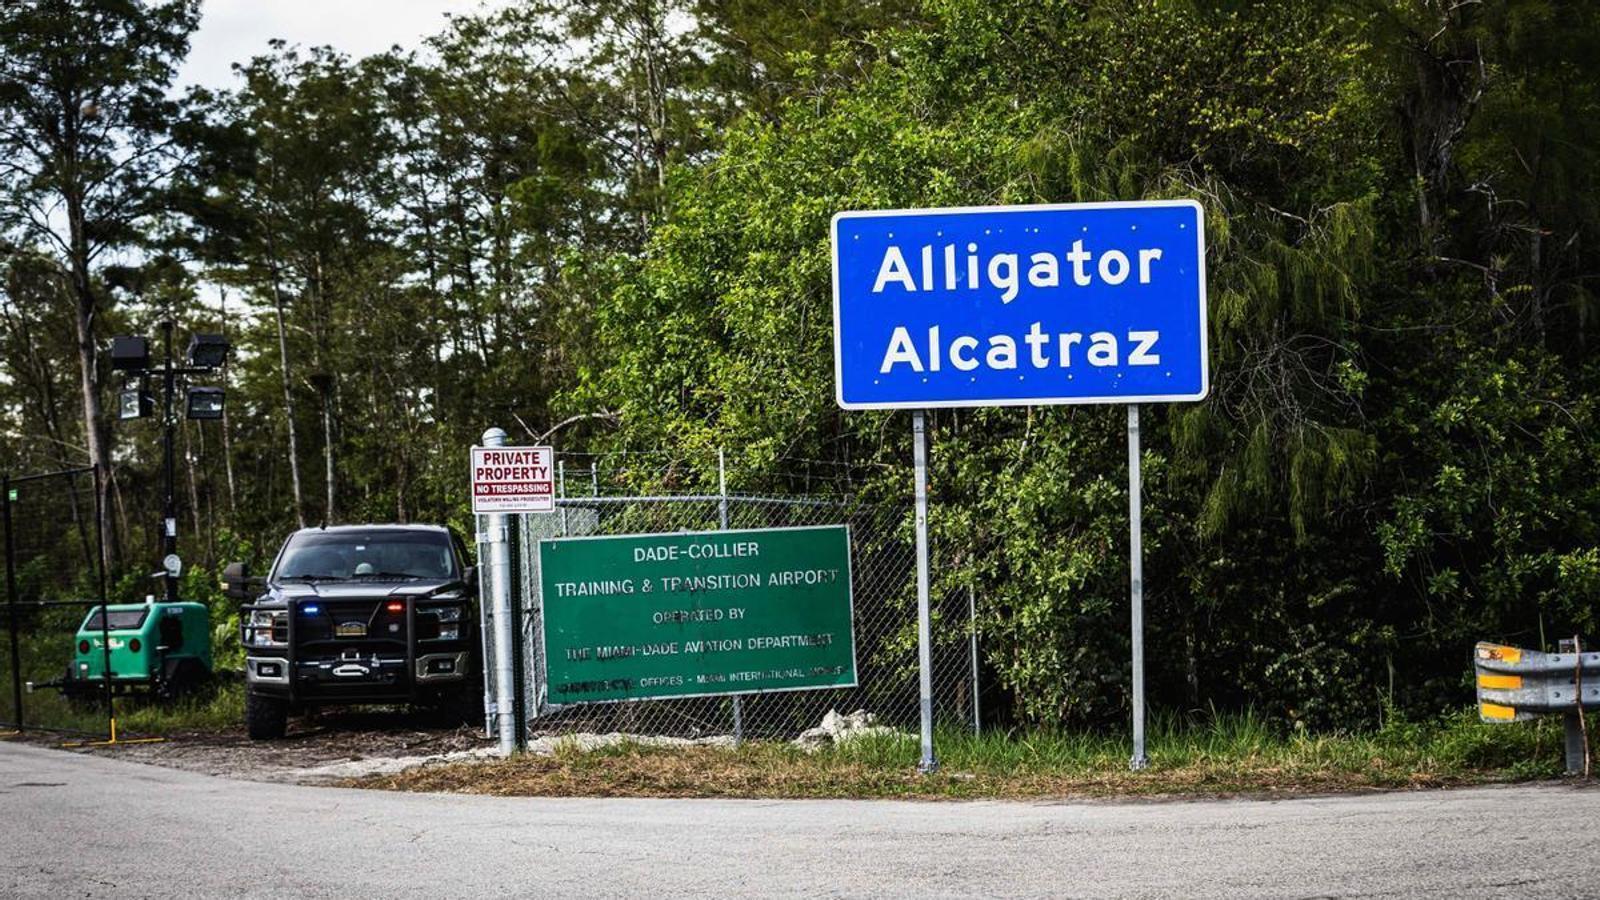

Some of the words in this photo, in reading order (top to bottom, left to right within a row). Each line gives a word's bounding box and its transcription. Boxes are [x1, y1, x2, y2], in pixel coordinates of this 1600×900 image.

[872, 239, 1163, 304] Alligator
[879, 321, 1161, 374] Alcatraz
[484, 452, 540, 465] PRIVATE
[476, 467, 547, 480] PROPERTY
[476, 484, 489, 493] NO
[491, 483, 549, 493] TRESPASSING
[634, 541, 759, 563] DADE-COLLIER
[554, 579, 634, 597] TRAINING
[641, 578, 653, 593] &
[661, 573, 761, 592] TRANSITION
[768, 568, 839, 587] AIRPORT
[652, 608, 724, 624] OPERATED
[728, 607, 746, 620] BY
[596, 641, 678, 659] MIAMI-DADE
[684, 638, 742, 655] AVIATION
[640, 675, 683, 688] OFFICES
